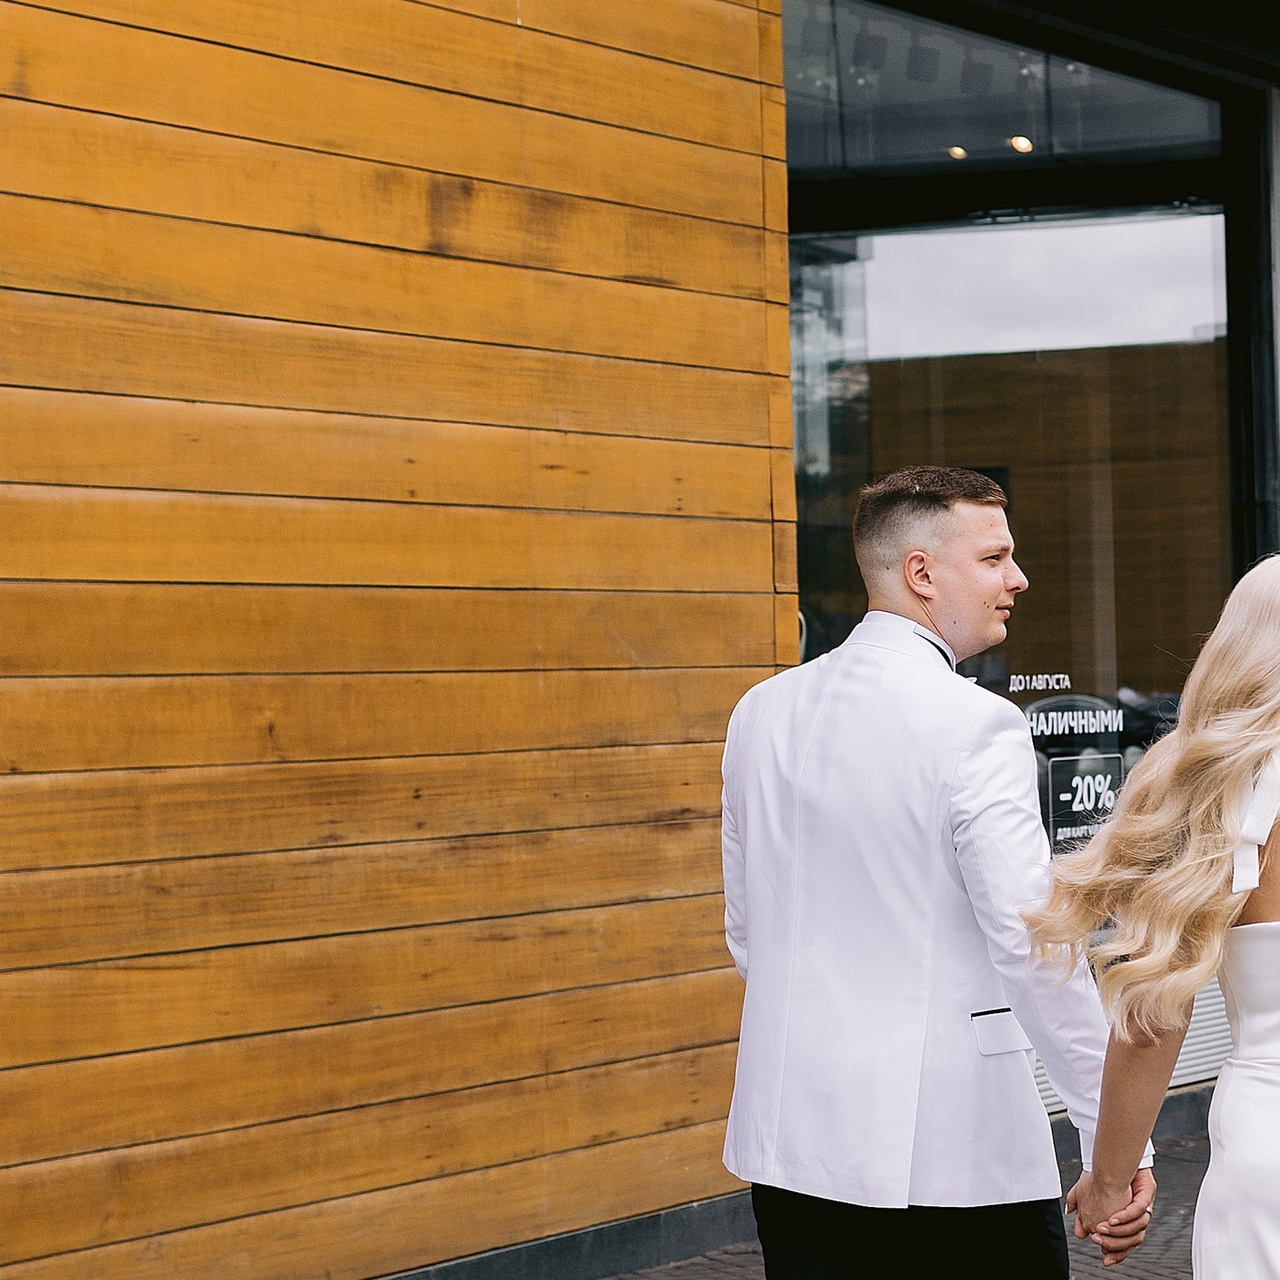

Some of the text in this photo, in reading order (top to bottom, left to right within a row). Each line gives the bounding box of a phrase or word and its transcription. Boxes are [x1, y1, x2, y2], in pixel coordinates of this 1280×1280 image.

[1009, 674, 1071, 693] ДО 1 АВГУСТА
[1027, 709, 1124, 736] НАЛИЧНЫМИ
[1059, 774, 1115, 811] -20%
